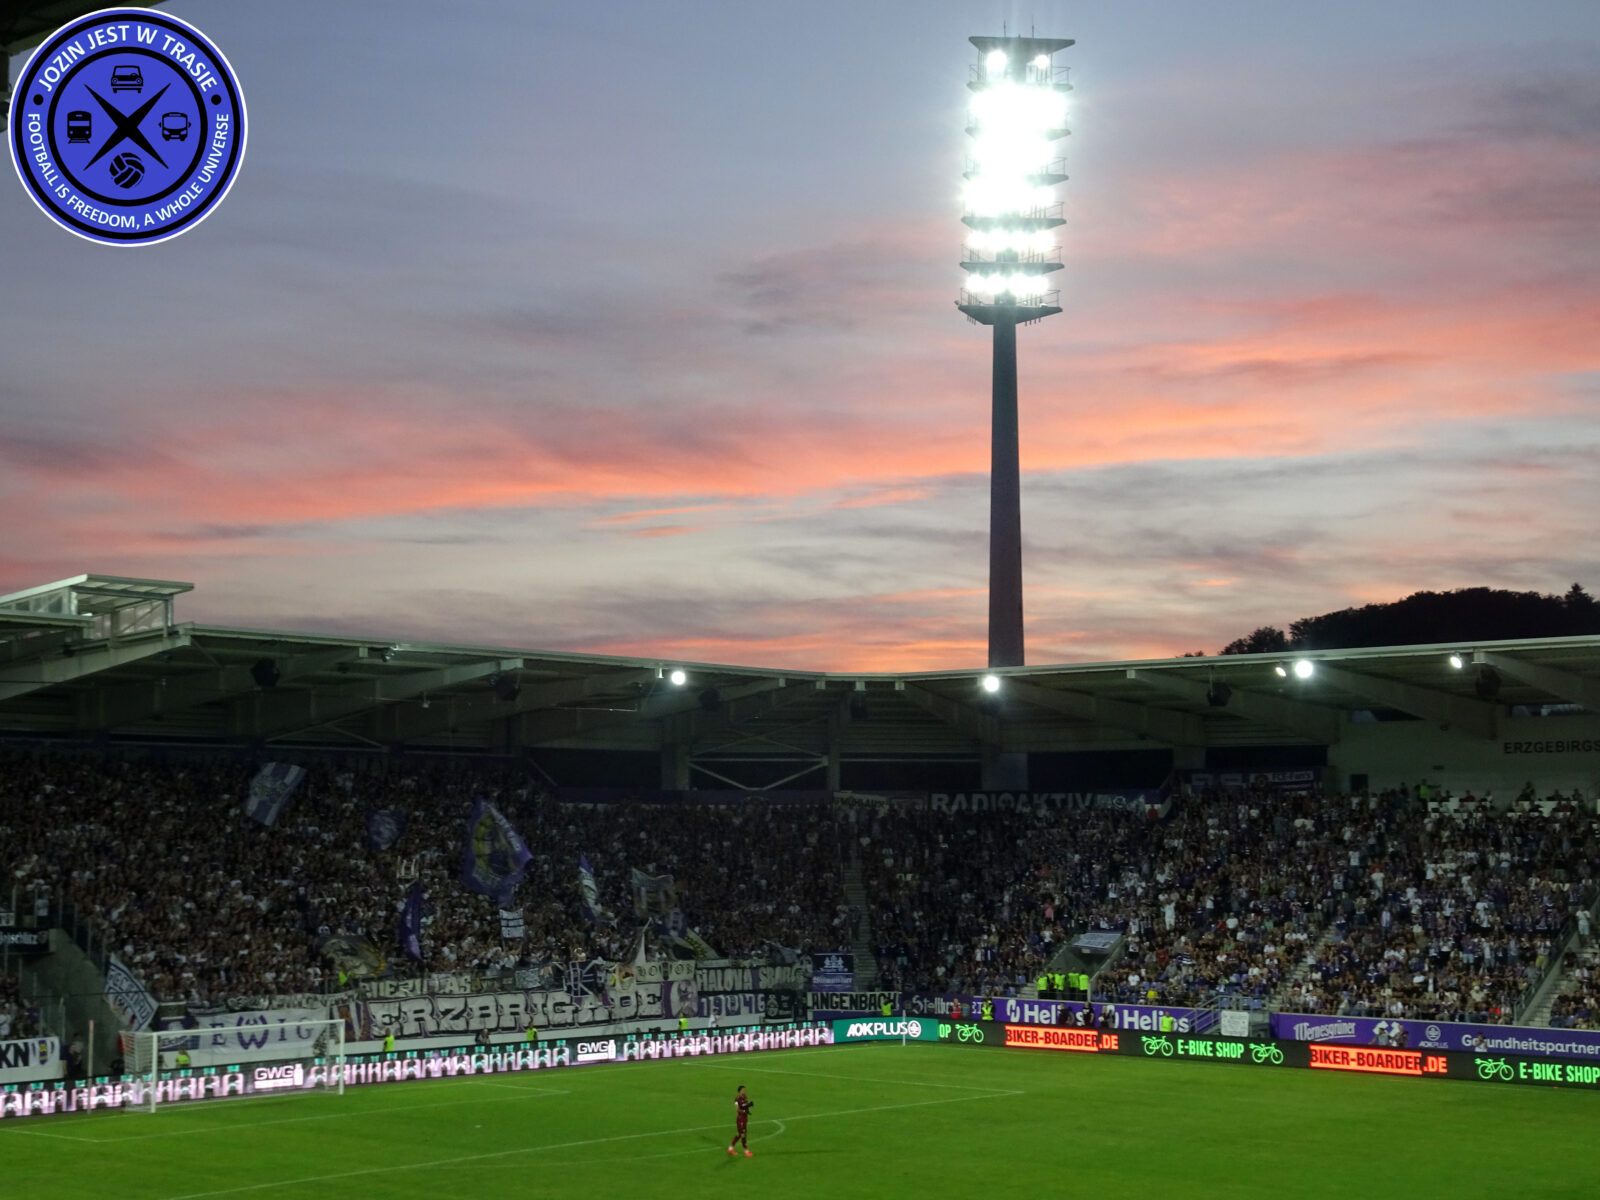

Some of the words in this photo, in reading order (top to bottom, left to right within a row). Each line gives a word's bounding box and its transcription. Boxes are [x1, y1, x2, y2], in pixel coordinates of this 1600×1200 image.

[1024, 1003, 1085, 1026] Hels
[1177, 1039, 1214, 1057] E-BIKE
[1215, 1041, 1245, 1059] SHOP
[1461, 1034, 1600, 1055] Geundheitspartner
[1519, 1062, 1563, 1081] E-BIKE
[1566, 1065, 1600, 1084] SHOP
